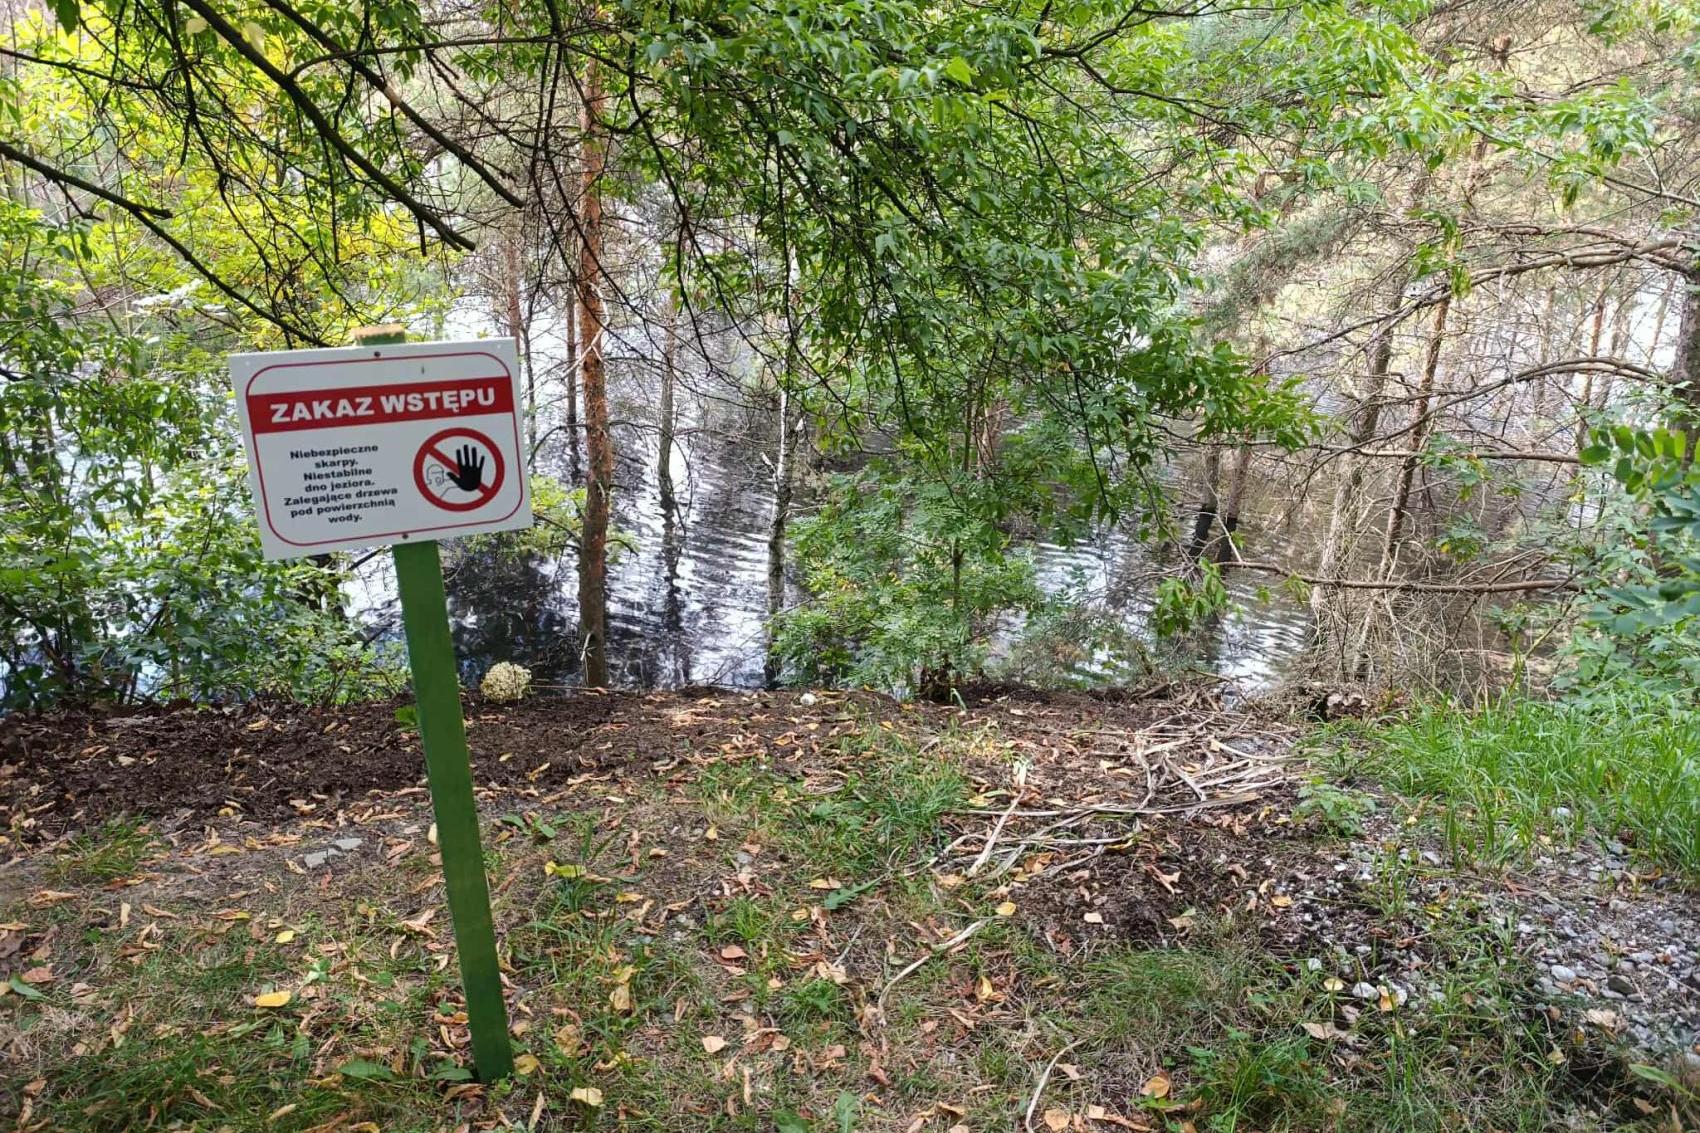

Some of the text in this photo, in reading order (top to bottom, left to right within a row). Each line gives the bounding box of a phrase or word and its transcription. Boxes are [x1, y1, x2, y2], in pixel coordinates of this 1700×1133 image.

[270, 387, 495, 423] ZAKAZ WSTĘPU
[290, 445, 379, 460] Niebezpieczne
[315, 459, 359, 469] skarpy.
[303, 468, 373, 481] Niestabilne
[305, 479, 375, 492] dno jeziora.
[284, 488, 398, 506] Zalegające drzewa
[290, 498, 396, 518] pod powierzchnią
[328, 513, 363, 523] wody.
